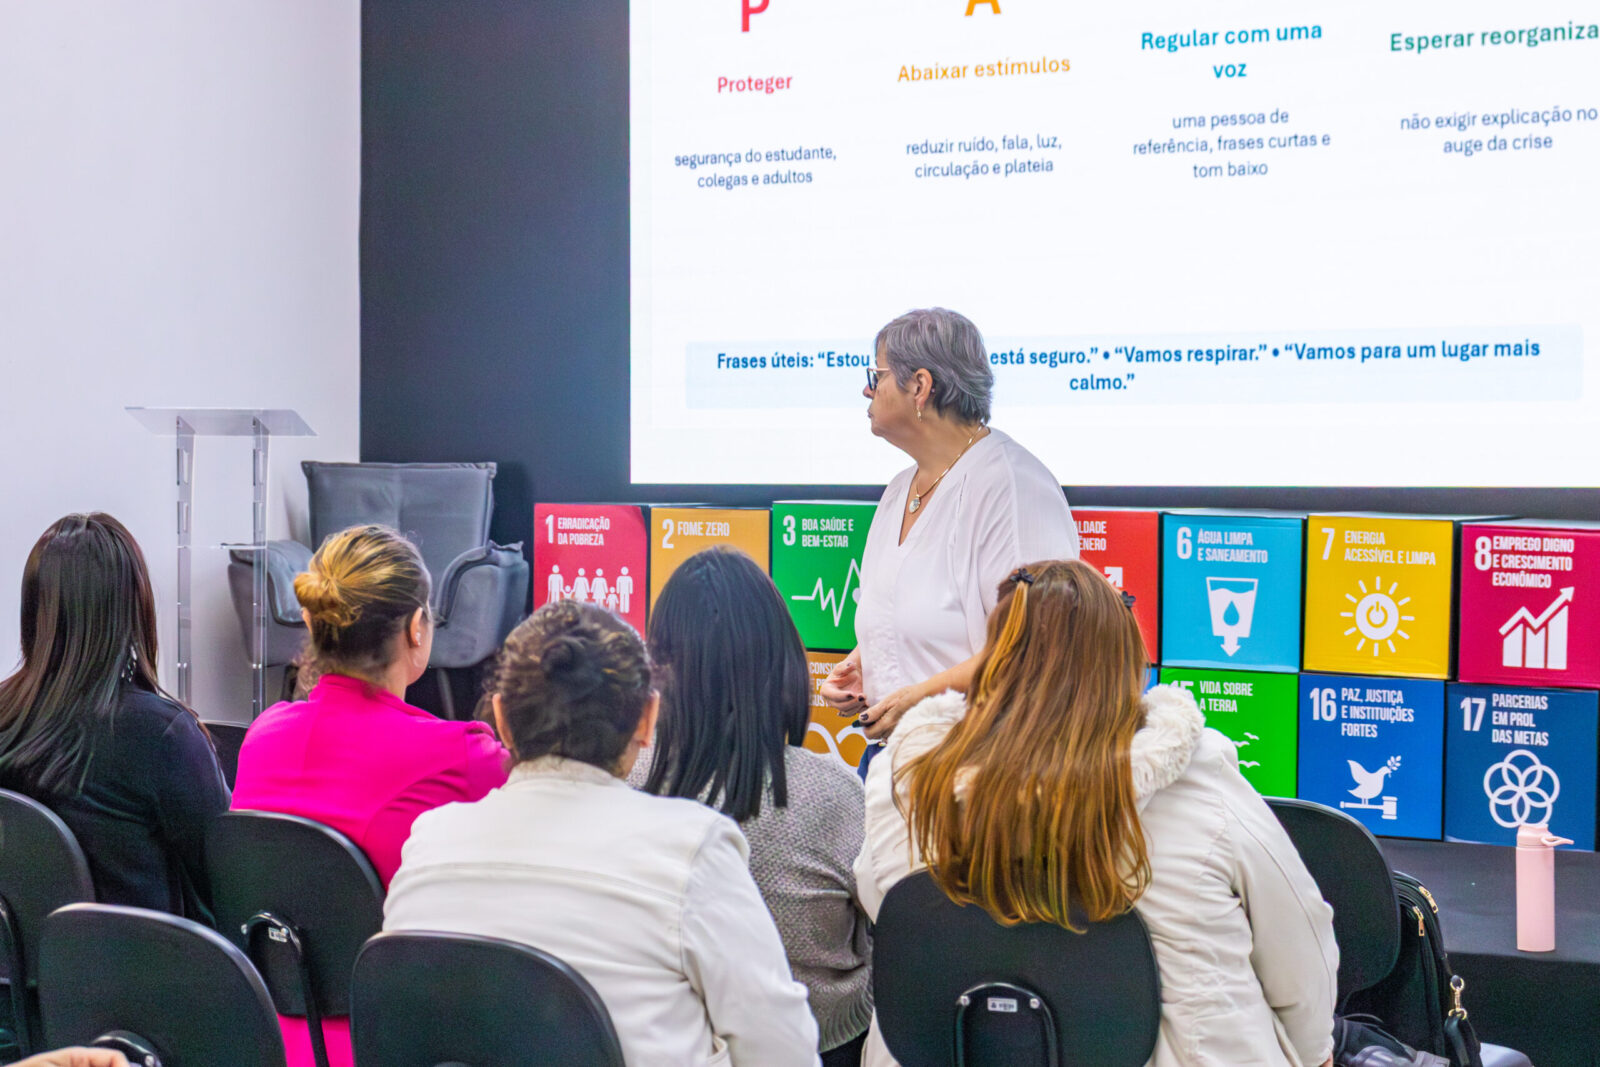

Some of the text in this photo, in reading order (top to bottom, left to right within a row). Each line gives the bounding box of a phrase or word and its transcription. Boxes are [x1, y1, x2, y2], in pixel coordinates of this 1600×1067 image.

[1142, 25, 1322, 53] Regular com uma
[1391, 33, 1474, 54] Esperar
[898, 56, 1070, 81] Abaixar estímulos
[1213, 63, 1247, 79] voz
[718, 76, 792, 94] Proteger
[1172, 108, 1289, 130] uma pessoa de
[1400, 106, 1598, 132] não exigir explicação no
[906, 134, 1062, 155] reduzir ruído, fala, luz,
[1133, 134, 1331, 155] referência, frases curtas e
[1443, 135, 1553, 157] auge da crise
[674, 146, 837, 170] segurança do estudante,
[914, 159, 1053, 180] circulação e plateia
[1193, 162, 1268, 178] tom baixo
[697, 170, 813, 190] colegas e adultos
[717, 353, 767, 369] Frases
[771, 352, 814, 368] úteis:
[990, 348, 1024, 365] está
[1361, 345, 1401, 363] para
[1407, 345, 1436, 358] um
[1442, 340, 1489, 362] lugar
[1494, 339, 1540, 357] mais
[545, 514, 554, 544] 1
[558, 516, 610, 532] ERRADICAÇÃO
[662, 518, 675, 549] 2
[677, 521, 730, 537] FOME ZERO
[782, 515, 796, 546] 3
[802, 517, 854, 532] BOA SAÚDE E
[557, 532, 604, 546] DA POBREZA
[802, 534, 849, 547] BEM-ESTAR
[1079, 535, 1107, 551] ÊNERO
[1176, 526, 1192, 560] 6
[1197, 528, 1254, 546] ÁGUA LIMPA
[1321, 527, 1335, 560] 7
[1344, 530, 1386, 545] ENERGIA
[1493, 536, 1575, 554] EMPREGO DIGNO
[1197, 547, 1268, 563] E SANEAMENTO
[1344, 547, 1436, 566] ACESSÍVEL E LIMPA
[1474, 535, 1492, 571] 8
[1492, 553, 1573, 571] E CRESCIMENTO
[1492, 570, 1552, 589] ECONÔMICO
[1199, 680, 1221, 694] VIDA
[1223, 682, 1253, 696] SOBRE
[1341, 687, 1404, 706] PAZ, JUSTIÇA
[1199, 697, 1238, 712] A TERRA
[1310, 687, 1337, 721] 16
[1492, 693, 1548, 710] PARCERIAS
[1341, 705, 1414, 724] E INSTITUIÇÕES
[1460, 697, 1486, 732] 17
[1492, 711, 1536, 728] EM PROL
[1341, 722, 1378, 738] FORTES
[1492, 729, 1549, 746] DAS METAS
